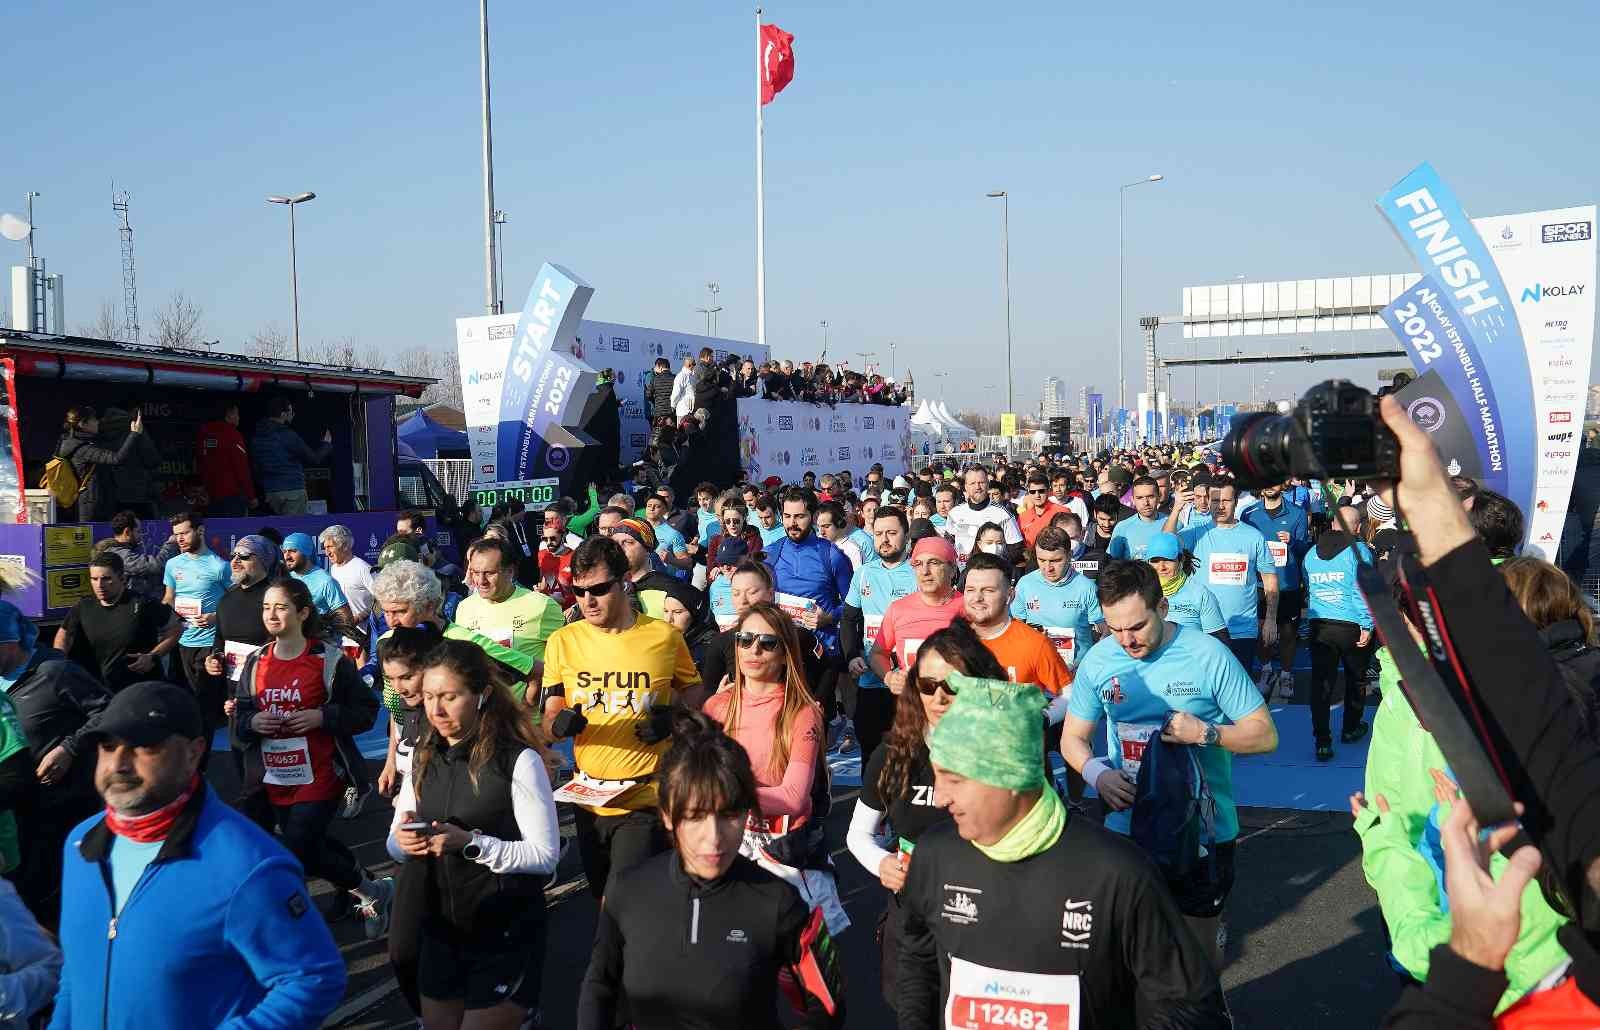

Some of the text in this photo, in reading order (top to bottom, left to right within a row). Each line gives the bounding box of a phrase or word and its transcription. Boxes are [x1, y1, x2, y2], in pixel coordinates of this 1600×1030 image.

[1544, 223, 1589, 235] SPOR
[1394, 187, 1498, 316] FINISH
[1543, 283, 1585, 297] KOLAY
[513, 278, 561, 383] START
[1394, 301, 1443, 365] 2022
[545, 366, 572, 416] 2022
[1427, 300, 1453, 328] KOLAY
[1469, 377, 1487, 406] HALF
[1479, 405, 1502, 472] MARATHON
[1310, 571, 1345, 584] STAFF
[577, 670, 651, 689] s-run
[264, 688, 302, 702] TEMA
[1062, 911, 1093, 931] NRC
[981, 1002, 1049, 1030] 12482
